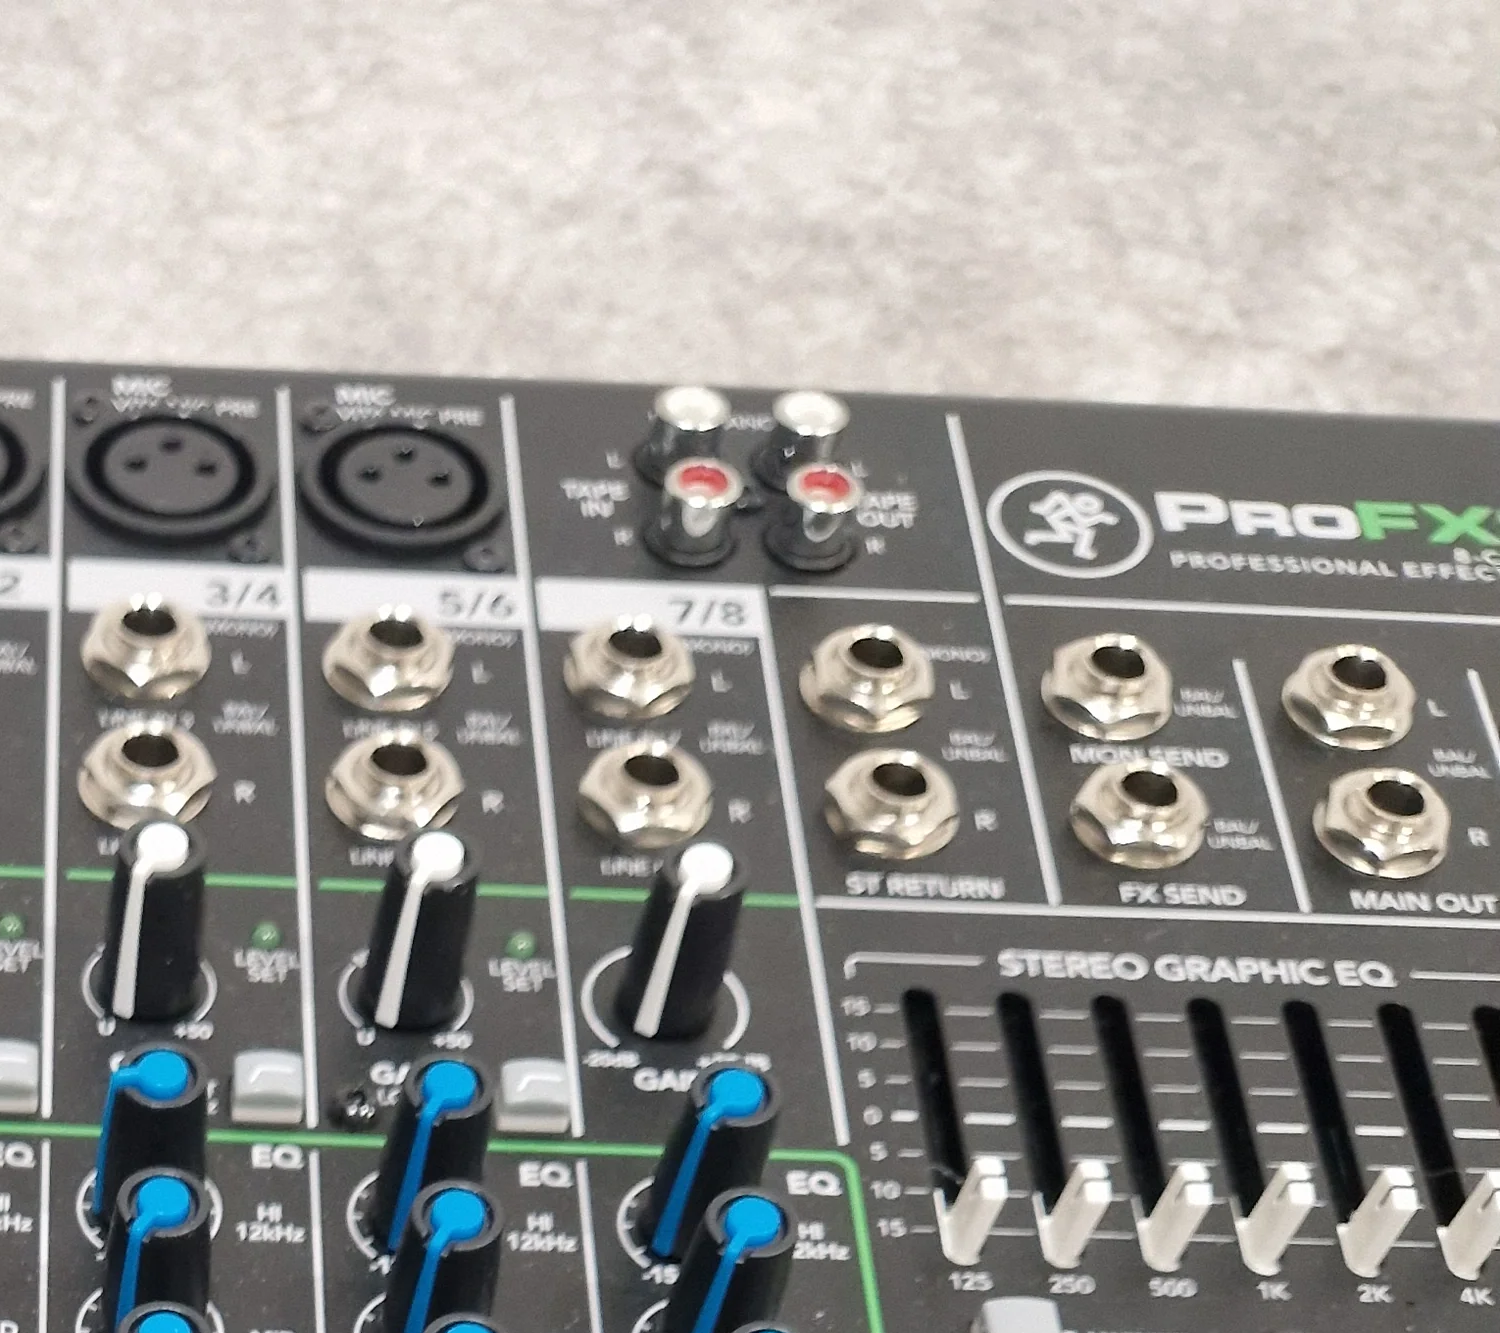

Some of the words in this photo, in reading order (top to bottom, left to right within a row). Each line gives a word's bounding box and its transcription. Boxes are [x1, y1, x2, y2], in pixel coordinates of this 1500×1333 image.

[1170, 550, 1397, 578] PROFESSIONAL
[668, 599, 747, 626] 7/8
[845, 874, 881, 896] ST
[887, 874, 1005, 900] RETURN
[1119, 881, 1157, 903] FX
[1164, 884, 1248, 907] SEND
[1350, 889, 1434, 912] MAIN
[1437, 892, 1499, 913] OUT
[998, 949, 1147, 981] STEREO
[1155, 955, 1327, 986] GRAPHIC
[1335, 960, 1397, 988] EQ
[251, 1145, 304, 1170] EQ
[518, 1161, 573, 1187] EQ
[257, 1204, 282, 1222] HI
[527, 1213, 553, 1232] HI
[235, 1222, 306, 1243] 12kHz
[506, 1232, 578, 1253] 12kHz
[949, 1272, 994, 1291] 125
[1048, 1275, 1095, 1295] 250
[1148, 1278, 1198, 1298] 500
[1256, 1281, 1292, 1300] 1K
[1357, 1283, 1394, 1302] 2K
[1459, 1287, 1495, 1306] 4K
